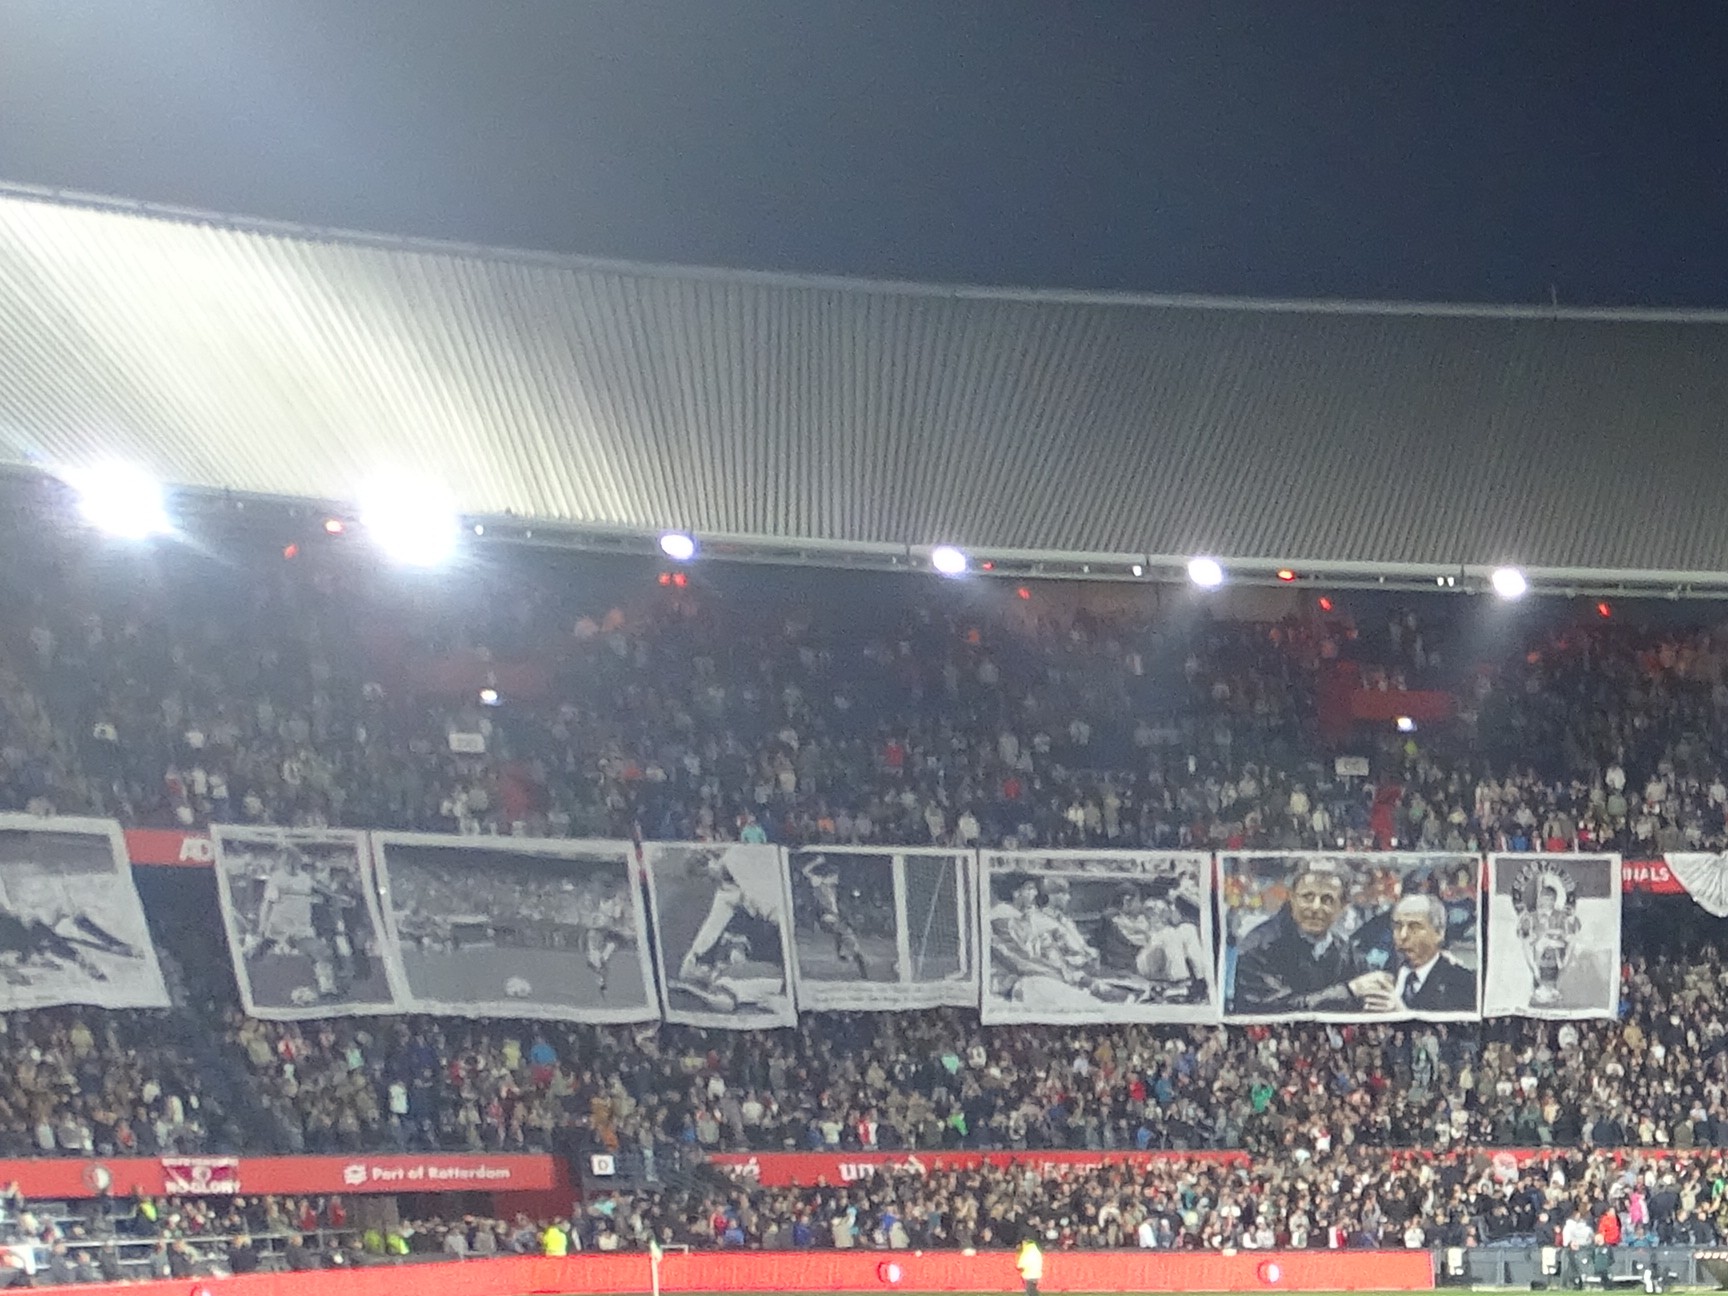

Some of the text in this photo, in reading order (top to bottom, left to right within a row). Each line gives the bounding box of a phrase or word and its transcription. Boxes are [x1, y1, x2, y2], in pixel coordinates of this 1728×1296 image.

[372, 1165, 511, 1181] Port of Rotterdam
